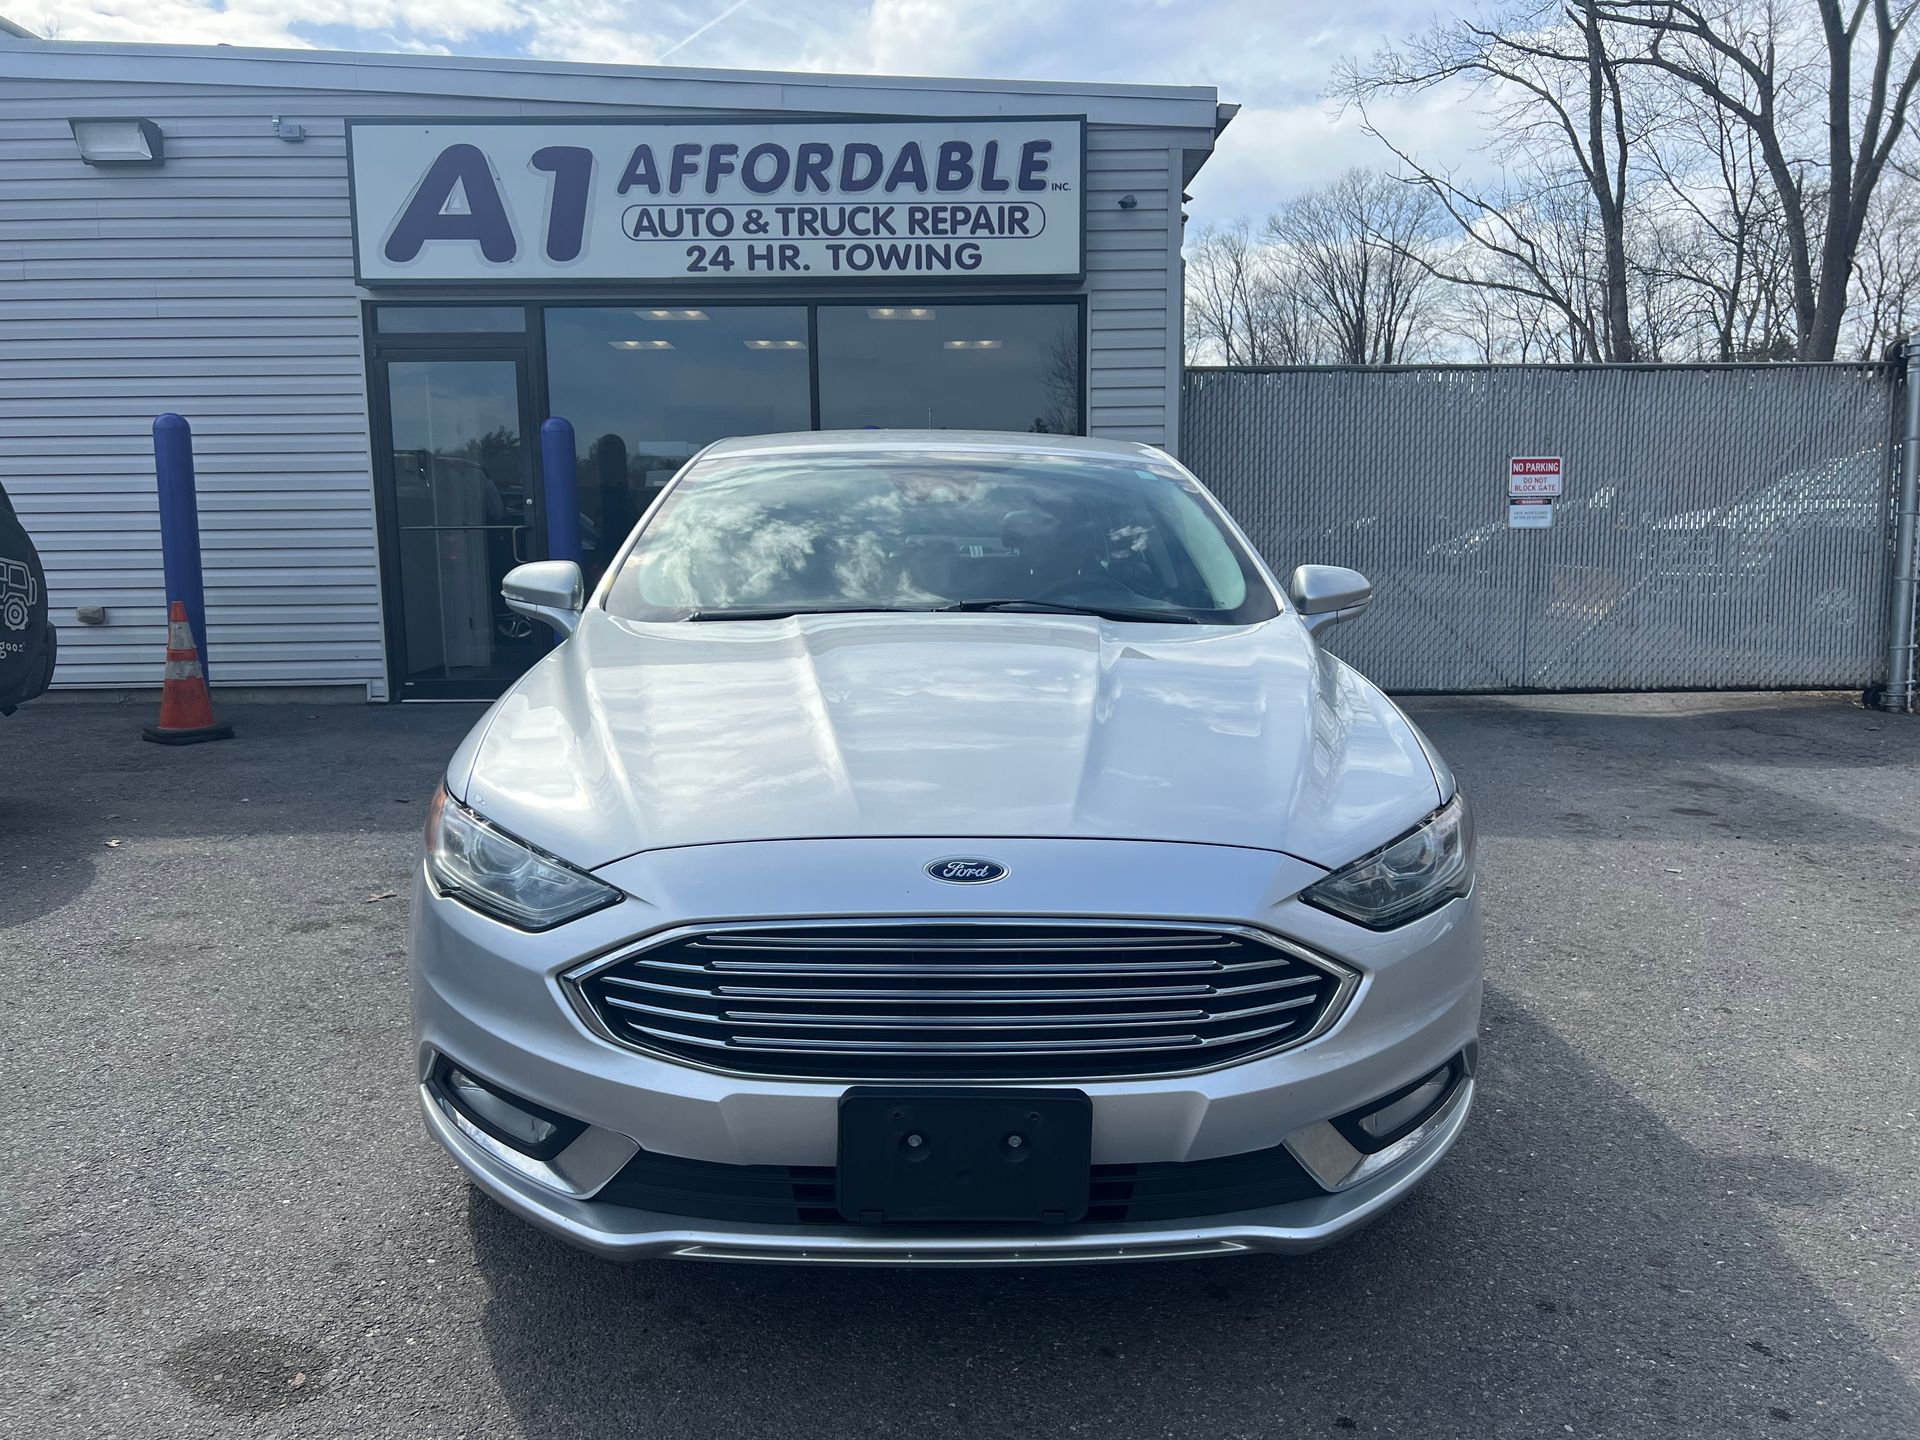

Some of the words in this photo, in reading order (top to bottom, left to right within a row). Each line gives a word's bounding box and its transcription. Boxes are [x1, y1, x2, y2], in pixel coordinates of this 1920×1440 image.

[616, 140, 1053, 195] AFFORDABLE
[1051, 182, 1072, 191] INC.
[383, 143, 595, 263] A1
[632, 206, 735, 238] AUTO
[741, 208, 770, 235] &
[774, 205, 898, 237] TRUCK
[907, 204, 1030, 236] REPAIR
[685, 244, 736, 272] 24
[747, 243, 811, 271] HR.
[824, 242, 983, 271] TOWING
[1513, 462, 1524, 472] NO
[1525, 462, 1559, 472] PARKING
[943, 861, 989, 877] Ford
